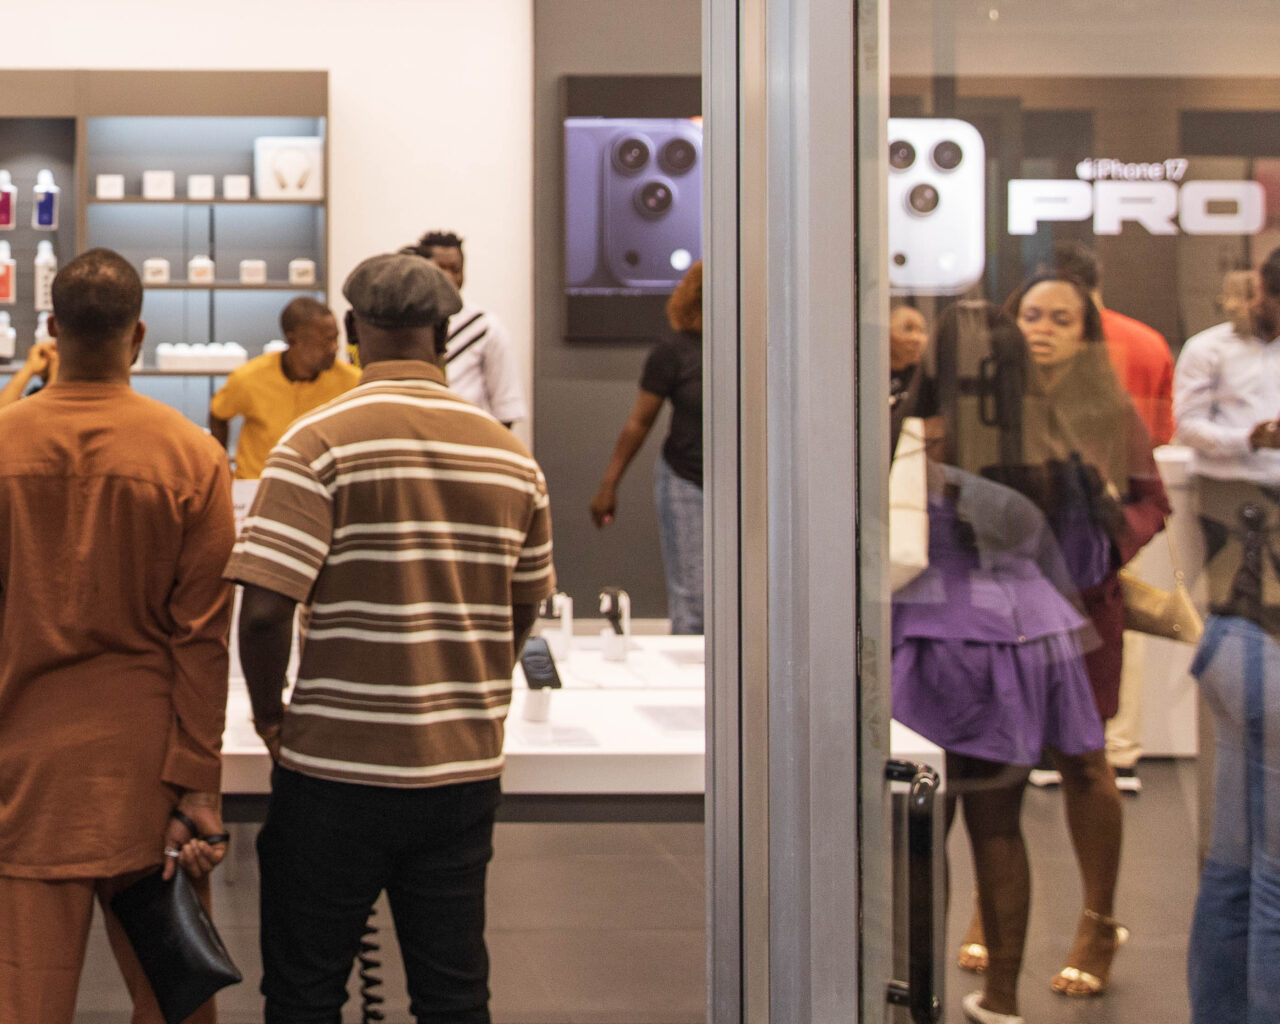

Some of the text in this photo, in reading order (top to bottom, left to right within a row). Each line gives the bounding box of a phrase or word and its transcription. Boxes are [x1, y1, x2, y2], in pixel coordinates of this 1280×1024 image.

[1092, 157, 1189, 182] iPhone 17
[1007, 178, 1266, 236] PRO
